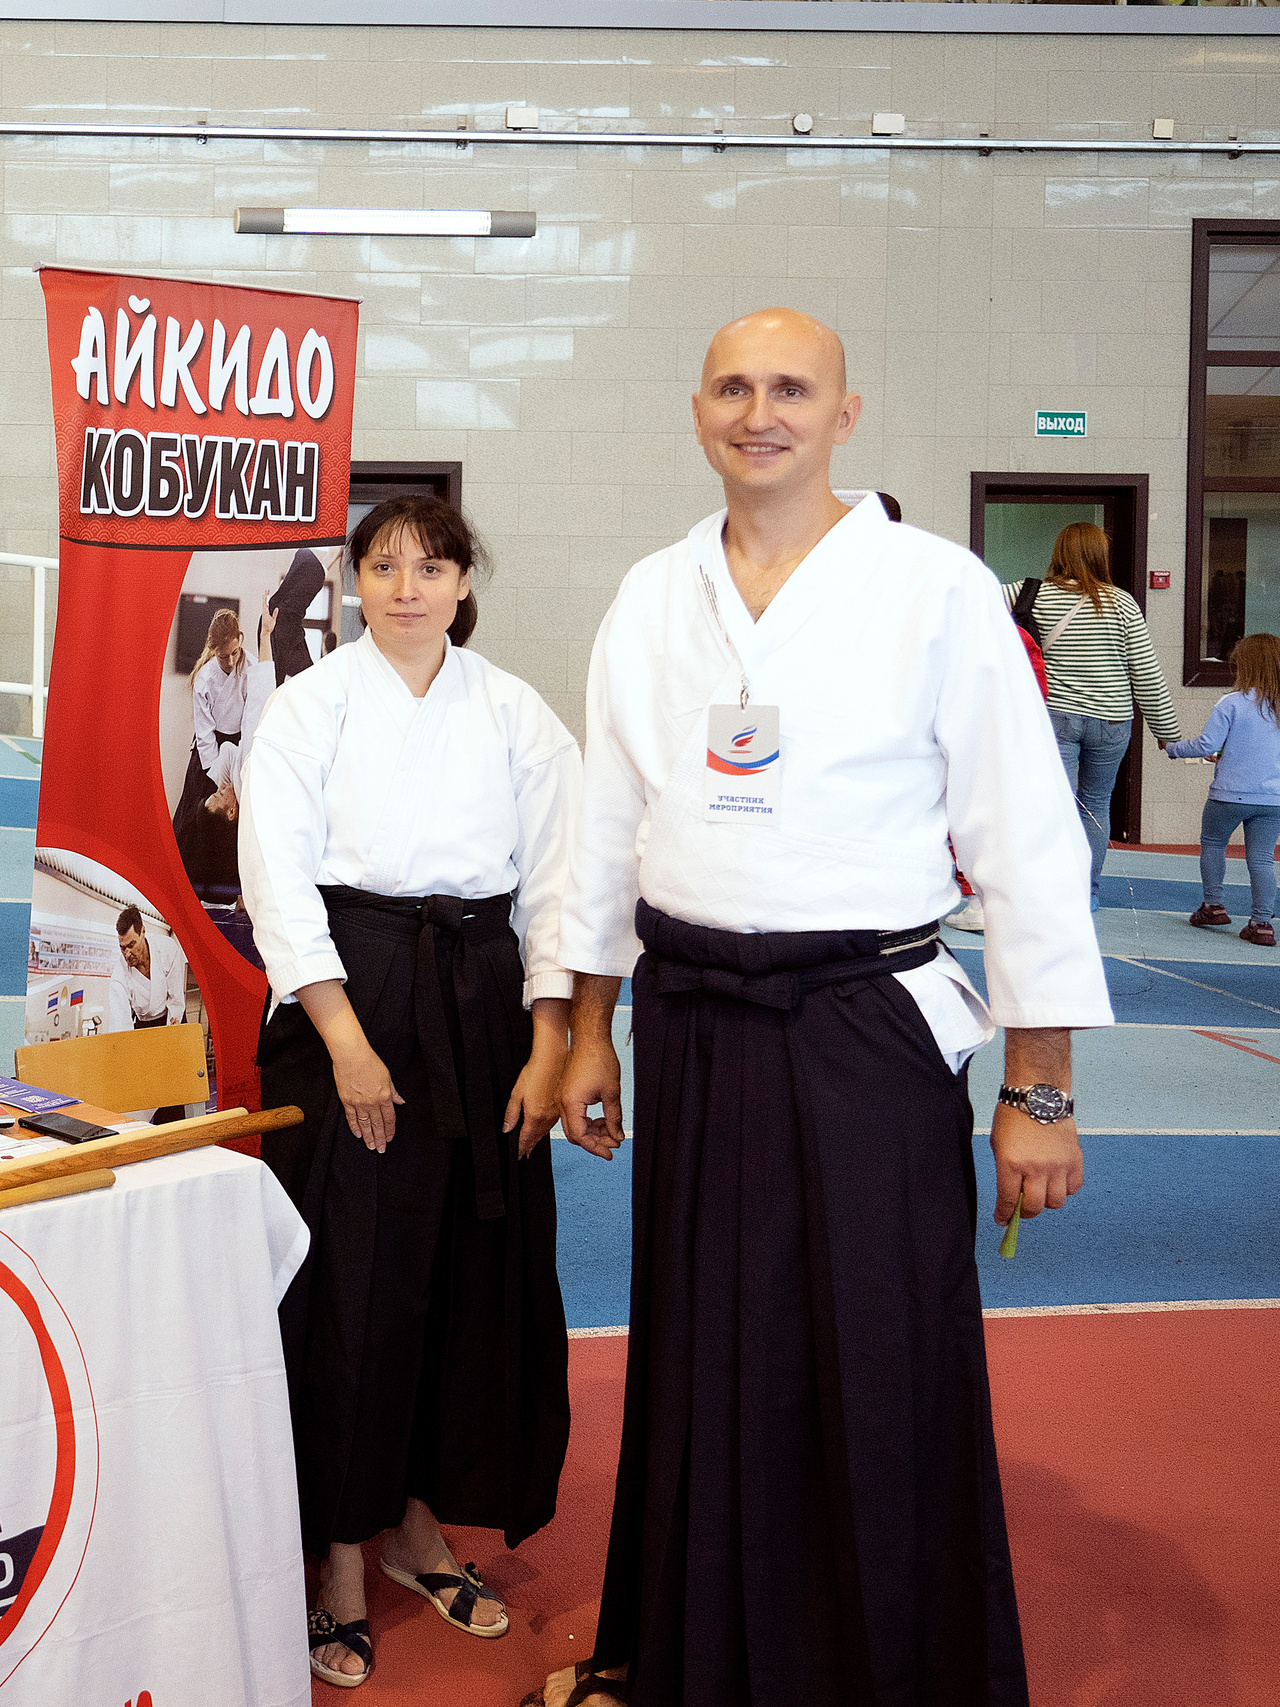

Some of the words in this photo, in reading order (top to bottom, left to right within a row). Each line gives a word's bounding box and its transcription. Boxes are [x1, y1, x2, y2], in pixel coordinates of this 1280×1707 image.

[71, 295, 335, 419] АЙКИДО
[1038, 417, 1084, 433] ВЫХОД
[80, 427, 319, 522] КОБУКАН
